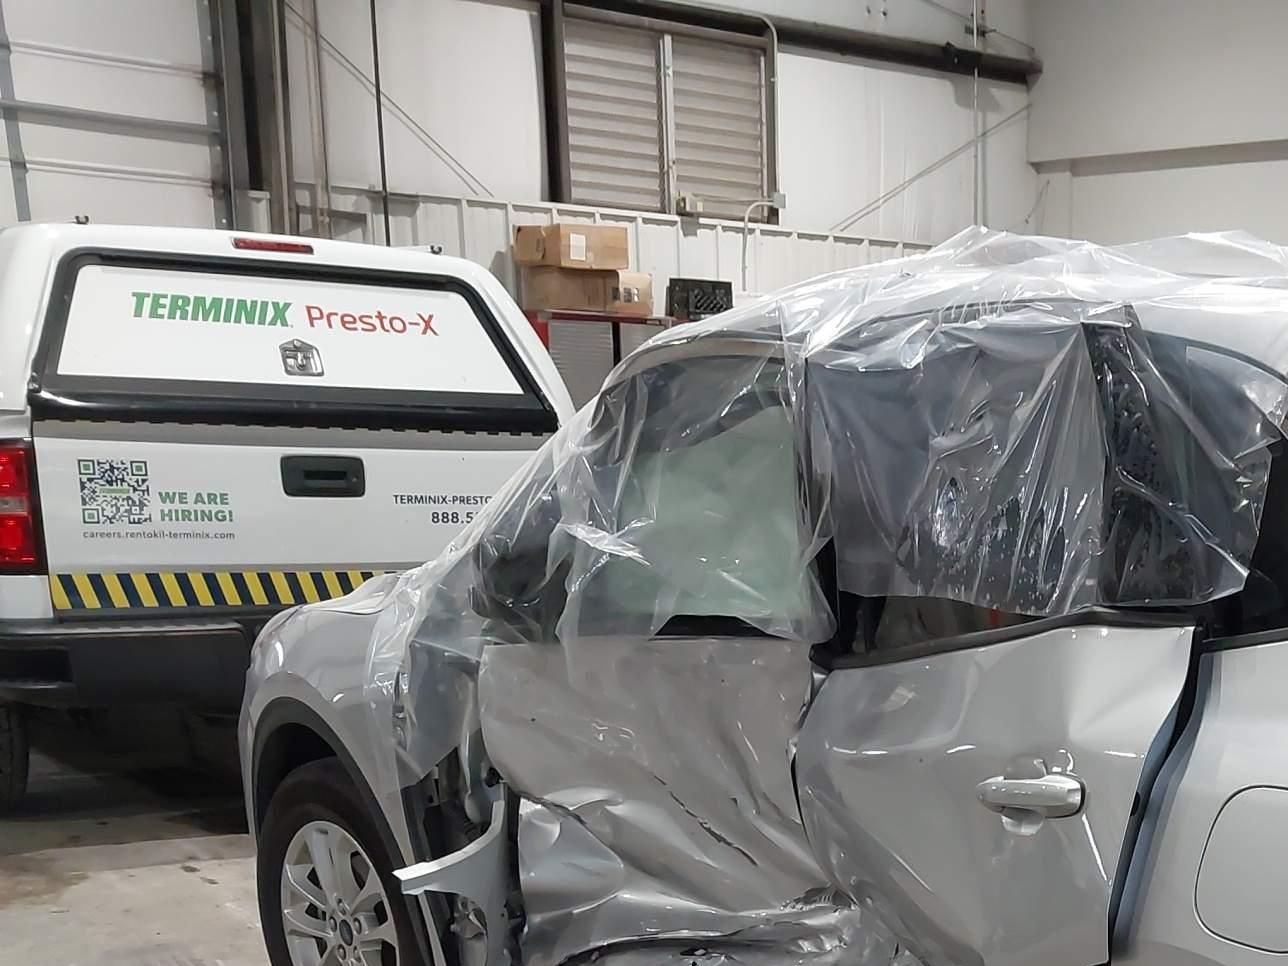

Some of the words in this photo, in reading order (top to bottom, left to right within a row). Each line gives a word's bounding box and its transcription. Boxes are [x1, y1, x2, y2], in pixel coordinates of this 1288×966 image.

[131, 291, 292, 328] TERMINIX
[305, 305, 439, 336] Presto-X
[158, 492, 188, 505] WE
[193, 493, 229, 506] ARE
[160, 509, 233, 523] HIRING!
[431, 511, 478, 524] 888.5
[83, 530, 235, 540] careers.rentokil-terminix.com
